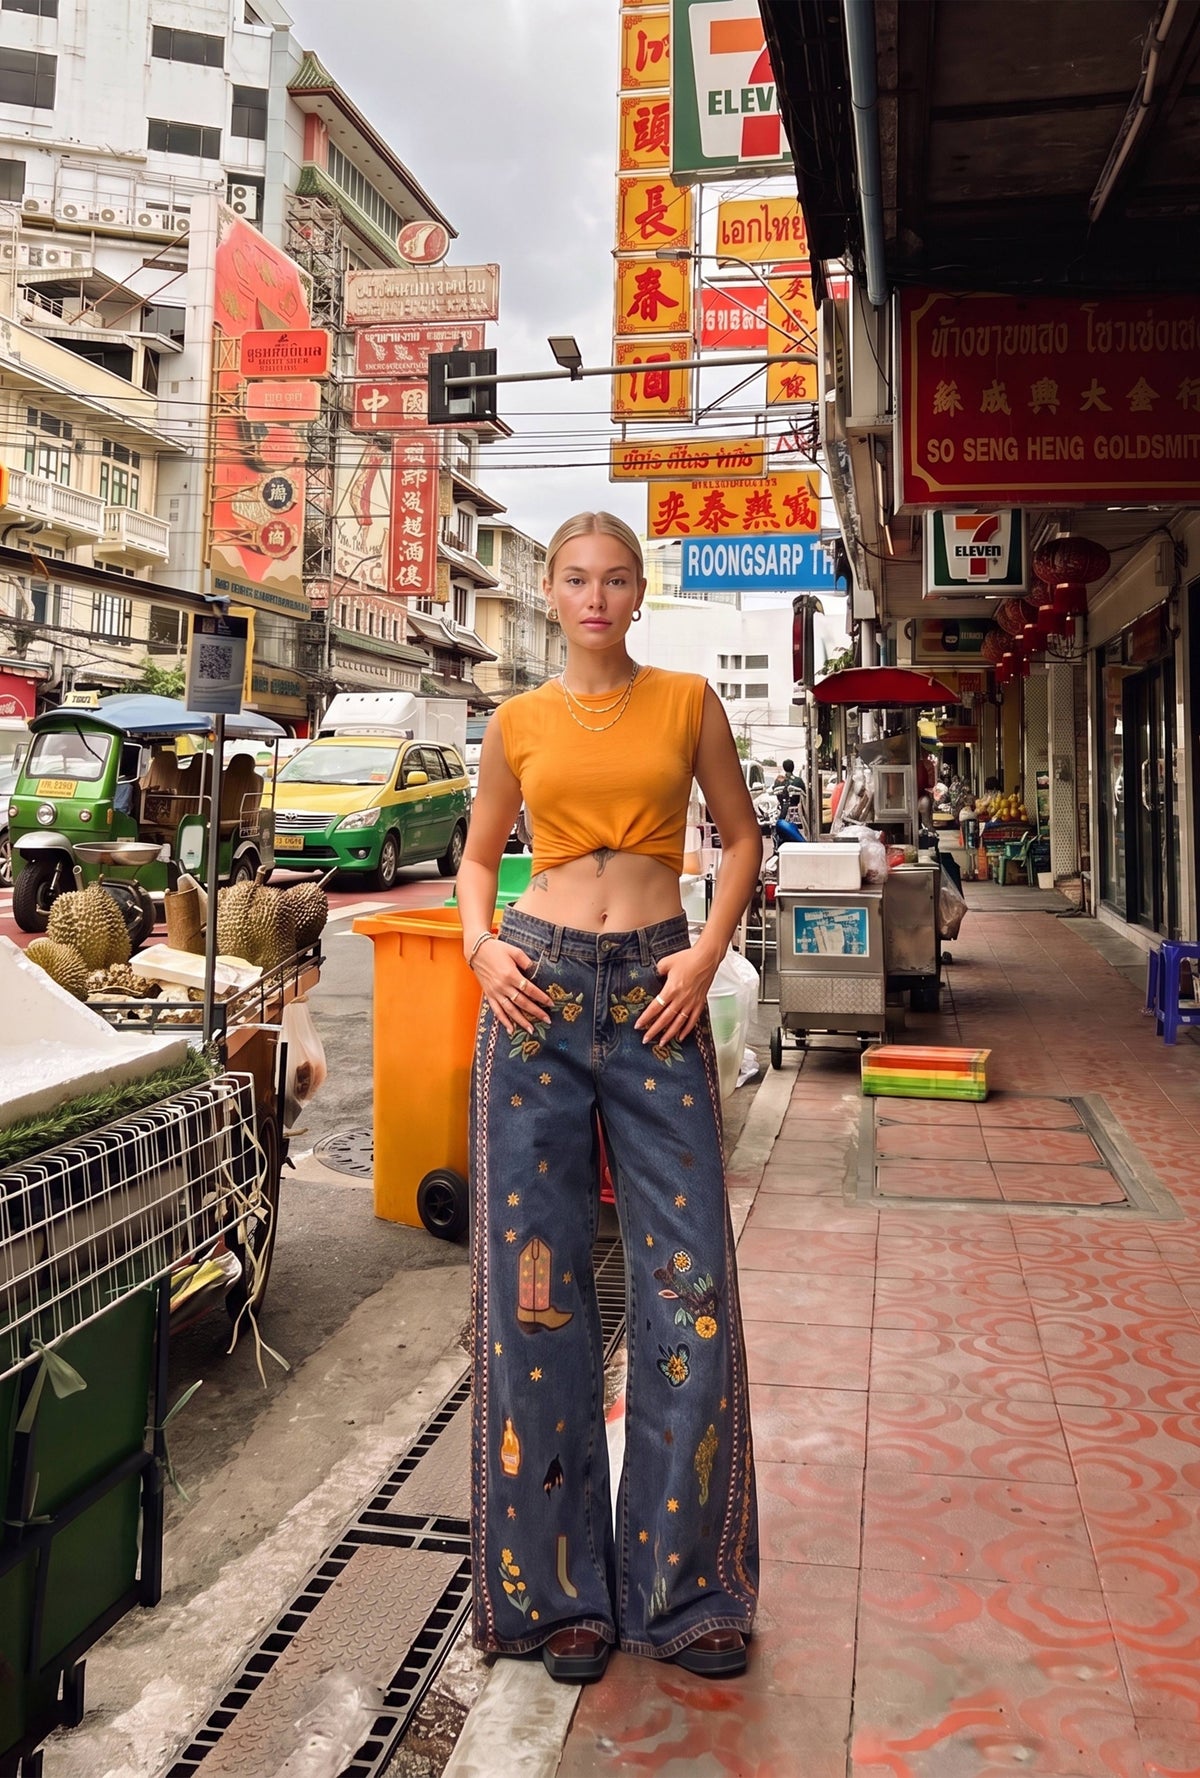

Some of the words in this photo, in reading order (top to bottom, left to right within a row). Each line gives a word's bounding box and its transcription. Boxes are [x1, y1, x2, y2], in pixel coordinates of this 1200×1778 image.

[708, 86, 778, 116] ELEV
[927, 438, 955, 463] SO
[963, 436, 1018, 462] SENG
[1027, 435, 1085, 461] HENG
[688, 543, 804, 577] ROONGSARP
[955, 516, 999, 574] 7
